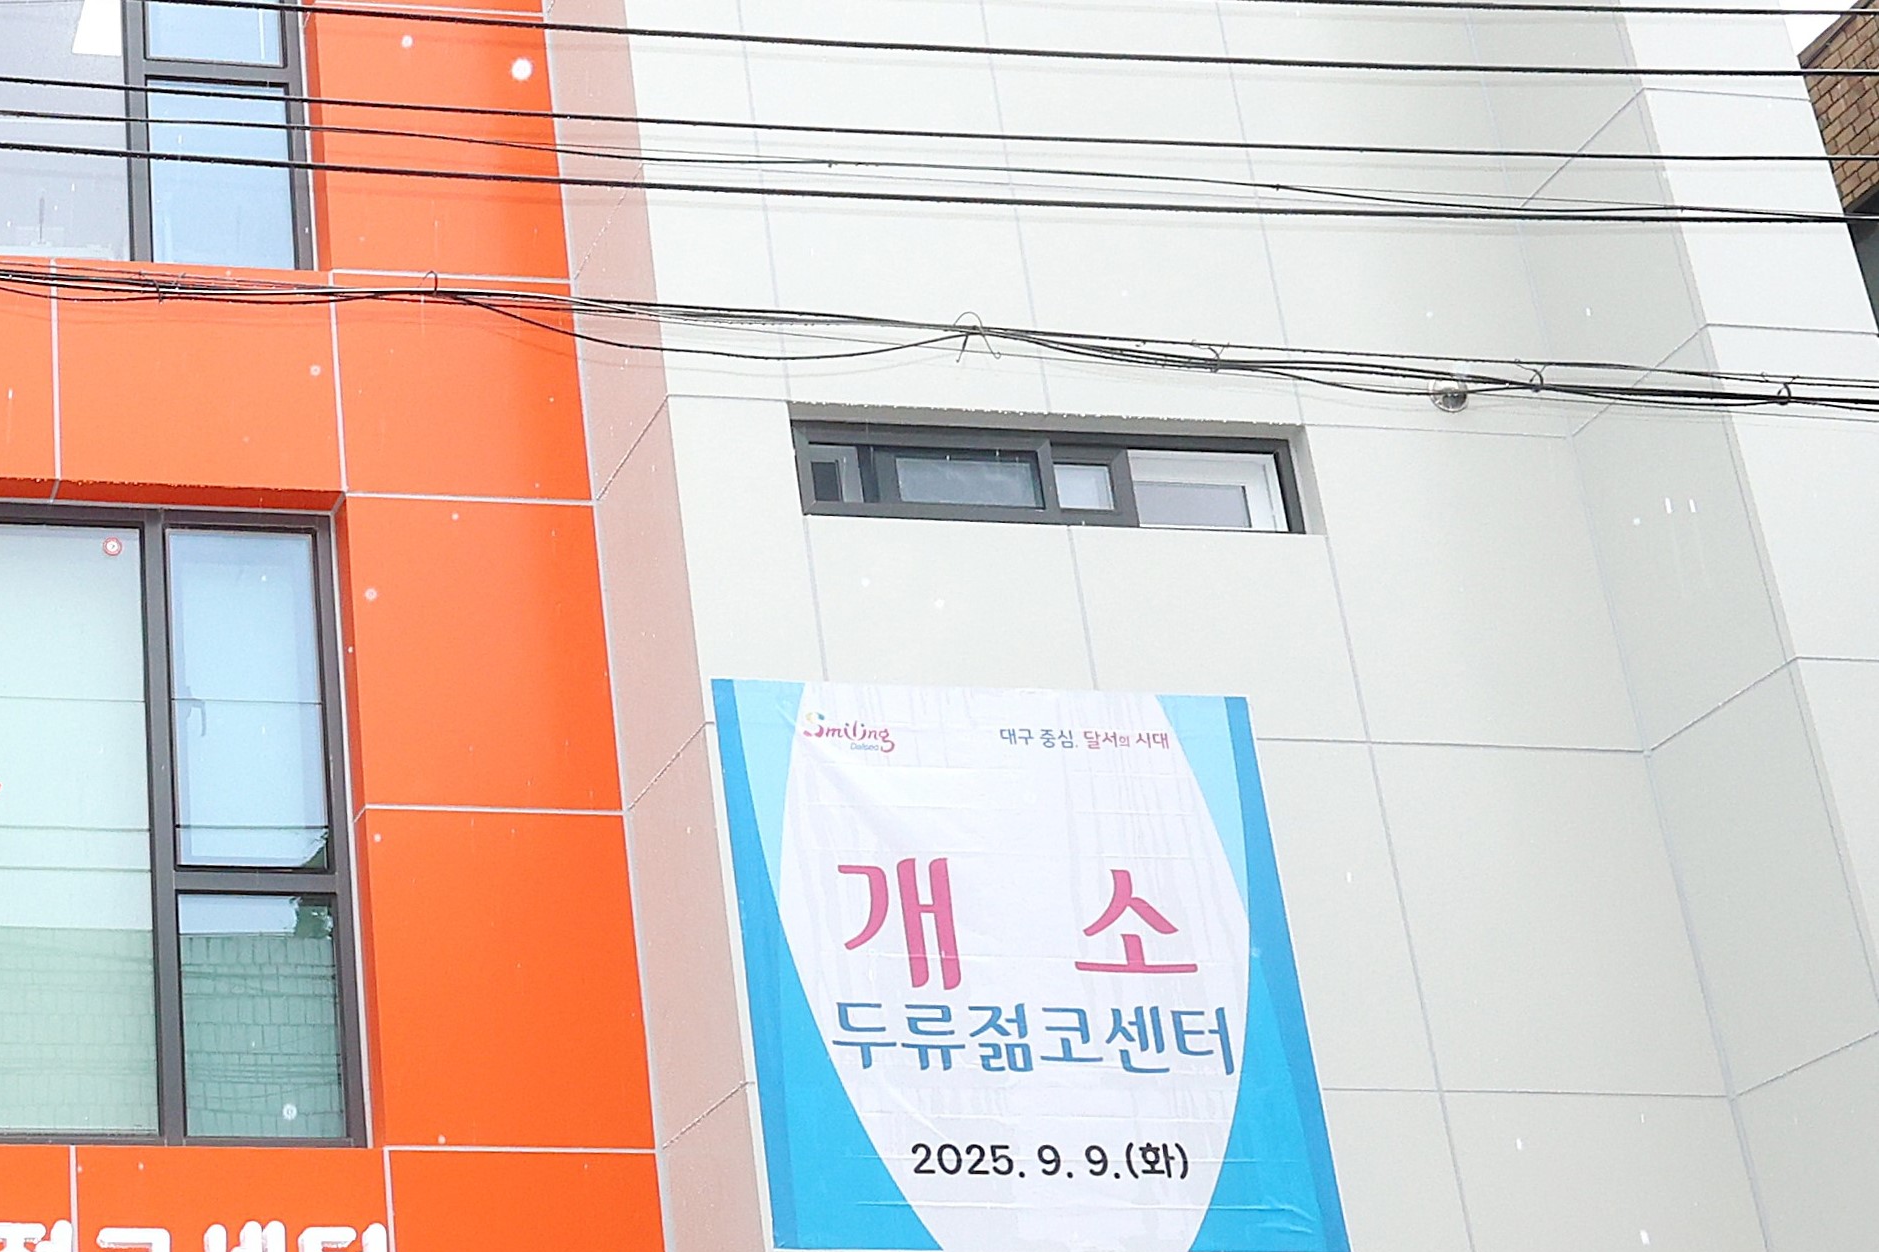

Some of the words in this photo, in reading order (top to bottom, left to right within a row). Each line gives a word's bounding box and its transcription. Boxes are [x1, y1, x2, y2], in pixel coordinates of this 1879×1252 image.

[803, 712, 895, 753] Smiling
[999, 728, 1034, 745] 대구
[1083, 730, 1130, 750] 달서의
[1135, 733, 1170, 749] 시대
[832, 1001, 1235, 1076] 두류젊코센터
[911, 1143, 1025, 1178] 2025.
